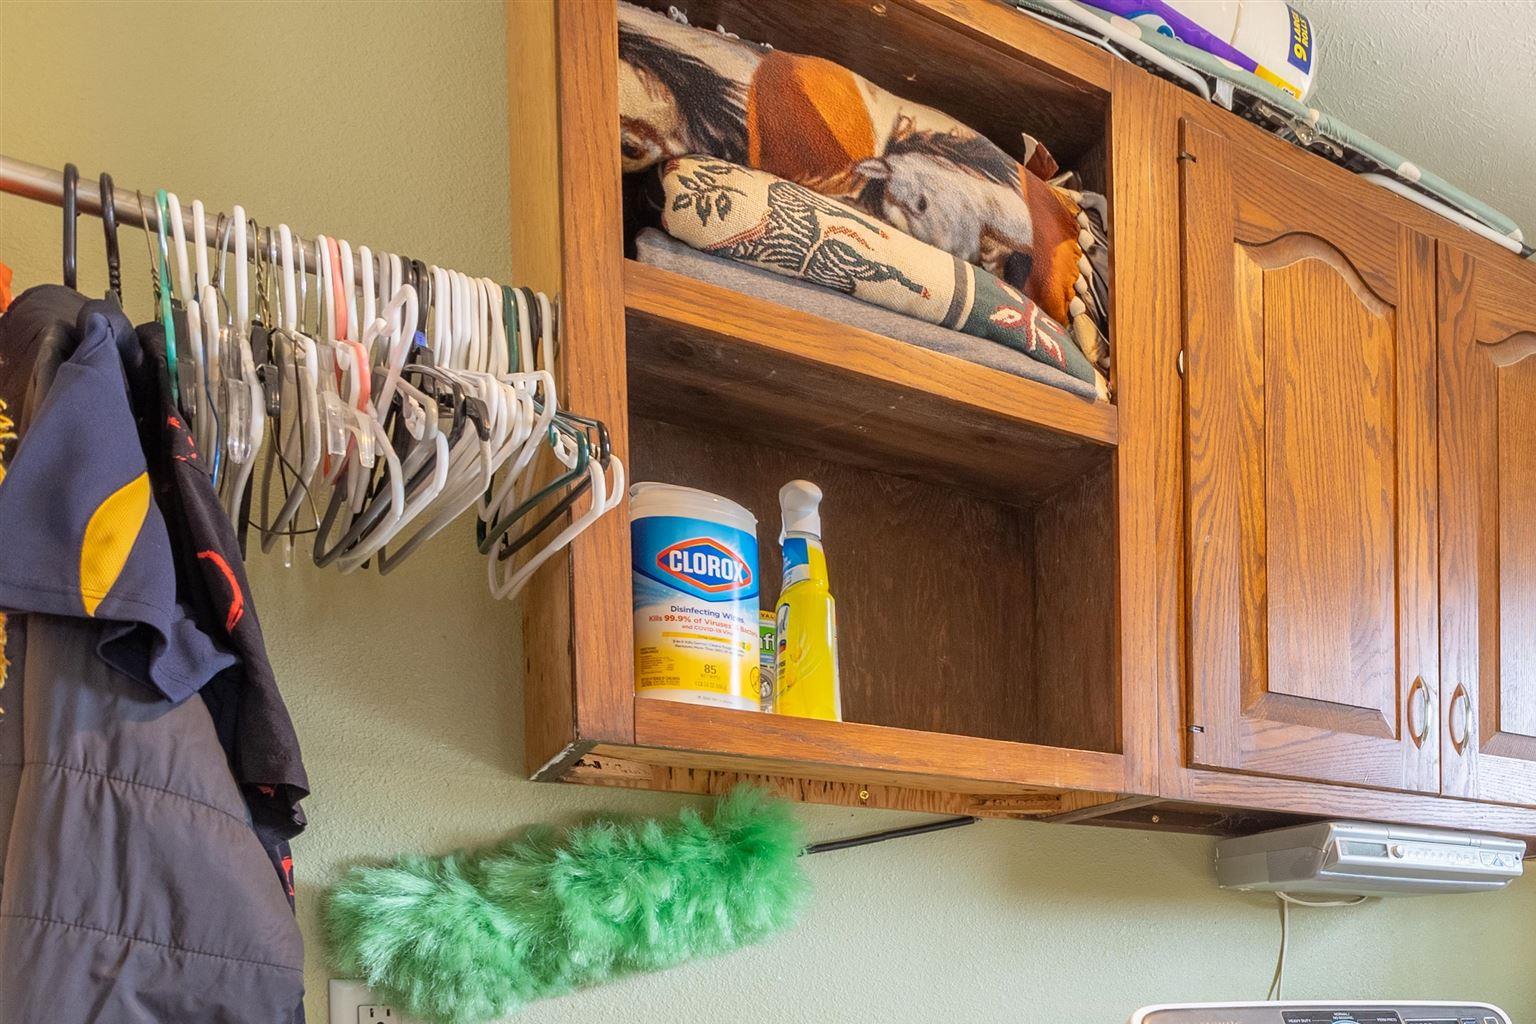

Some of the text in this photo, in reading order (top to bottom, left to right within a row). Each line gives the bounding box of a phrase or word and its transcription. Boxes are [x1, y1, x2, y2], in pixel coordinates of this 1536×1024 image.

[1294, 43, 1307, 62] 9
[668, 549, 744, 584] CLOROX
[664, 614, 691, 623] 99.9%
[670, 605, 745, 624] Disinfecting Wies
[703, 663, 717, 675] 85
